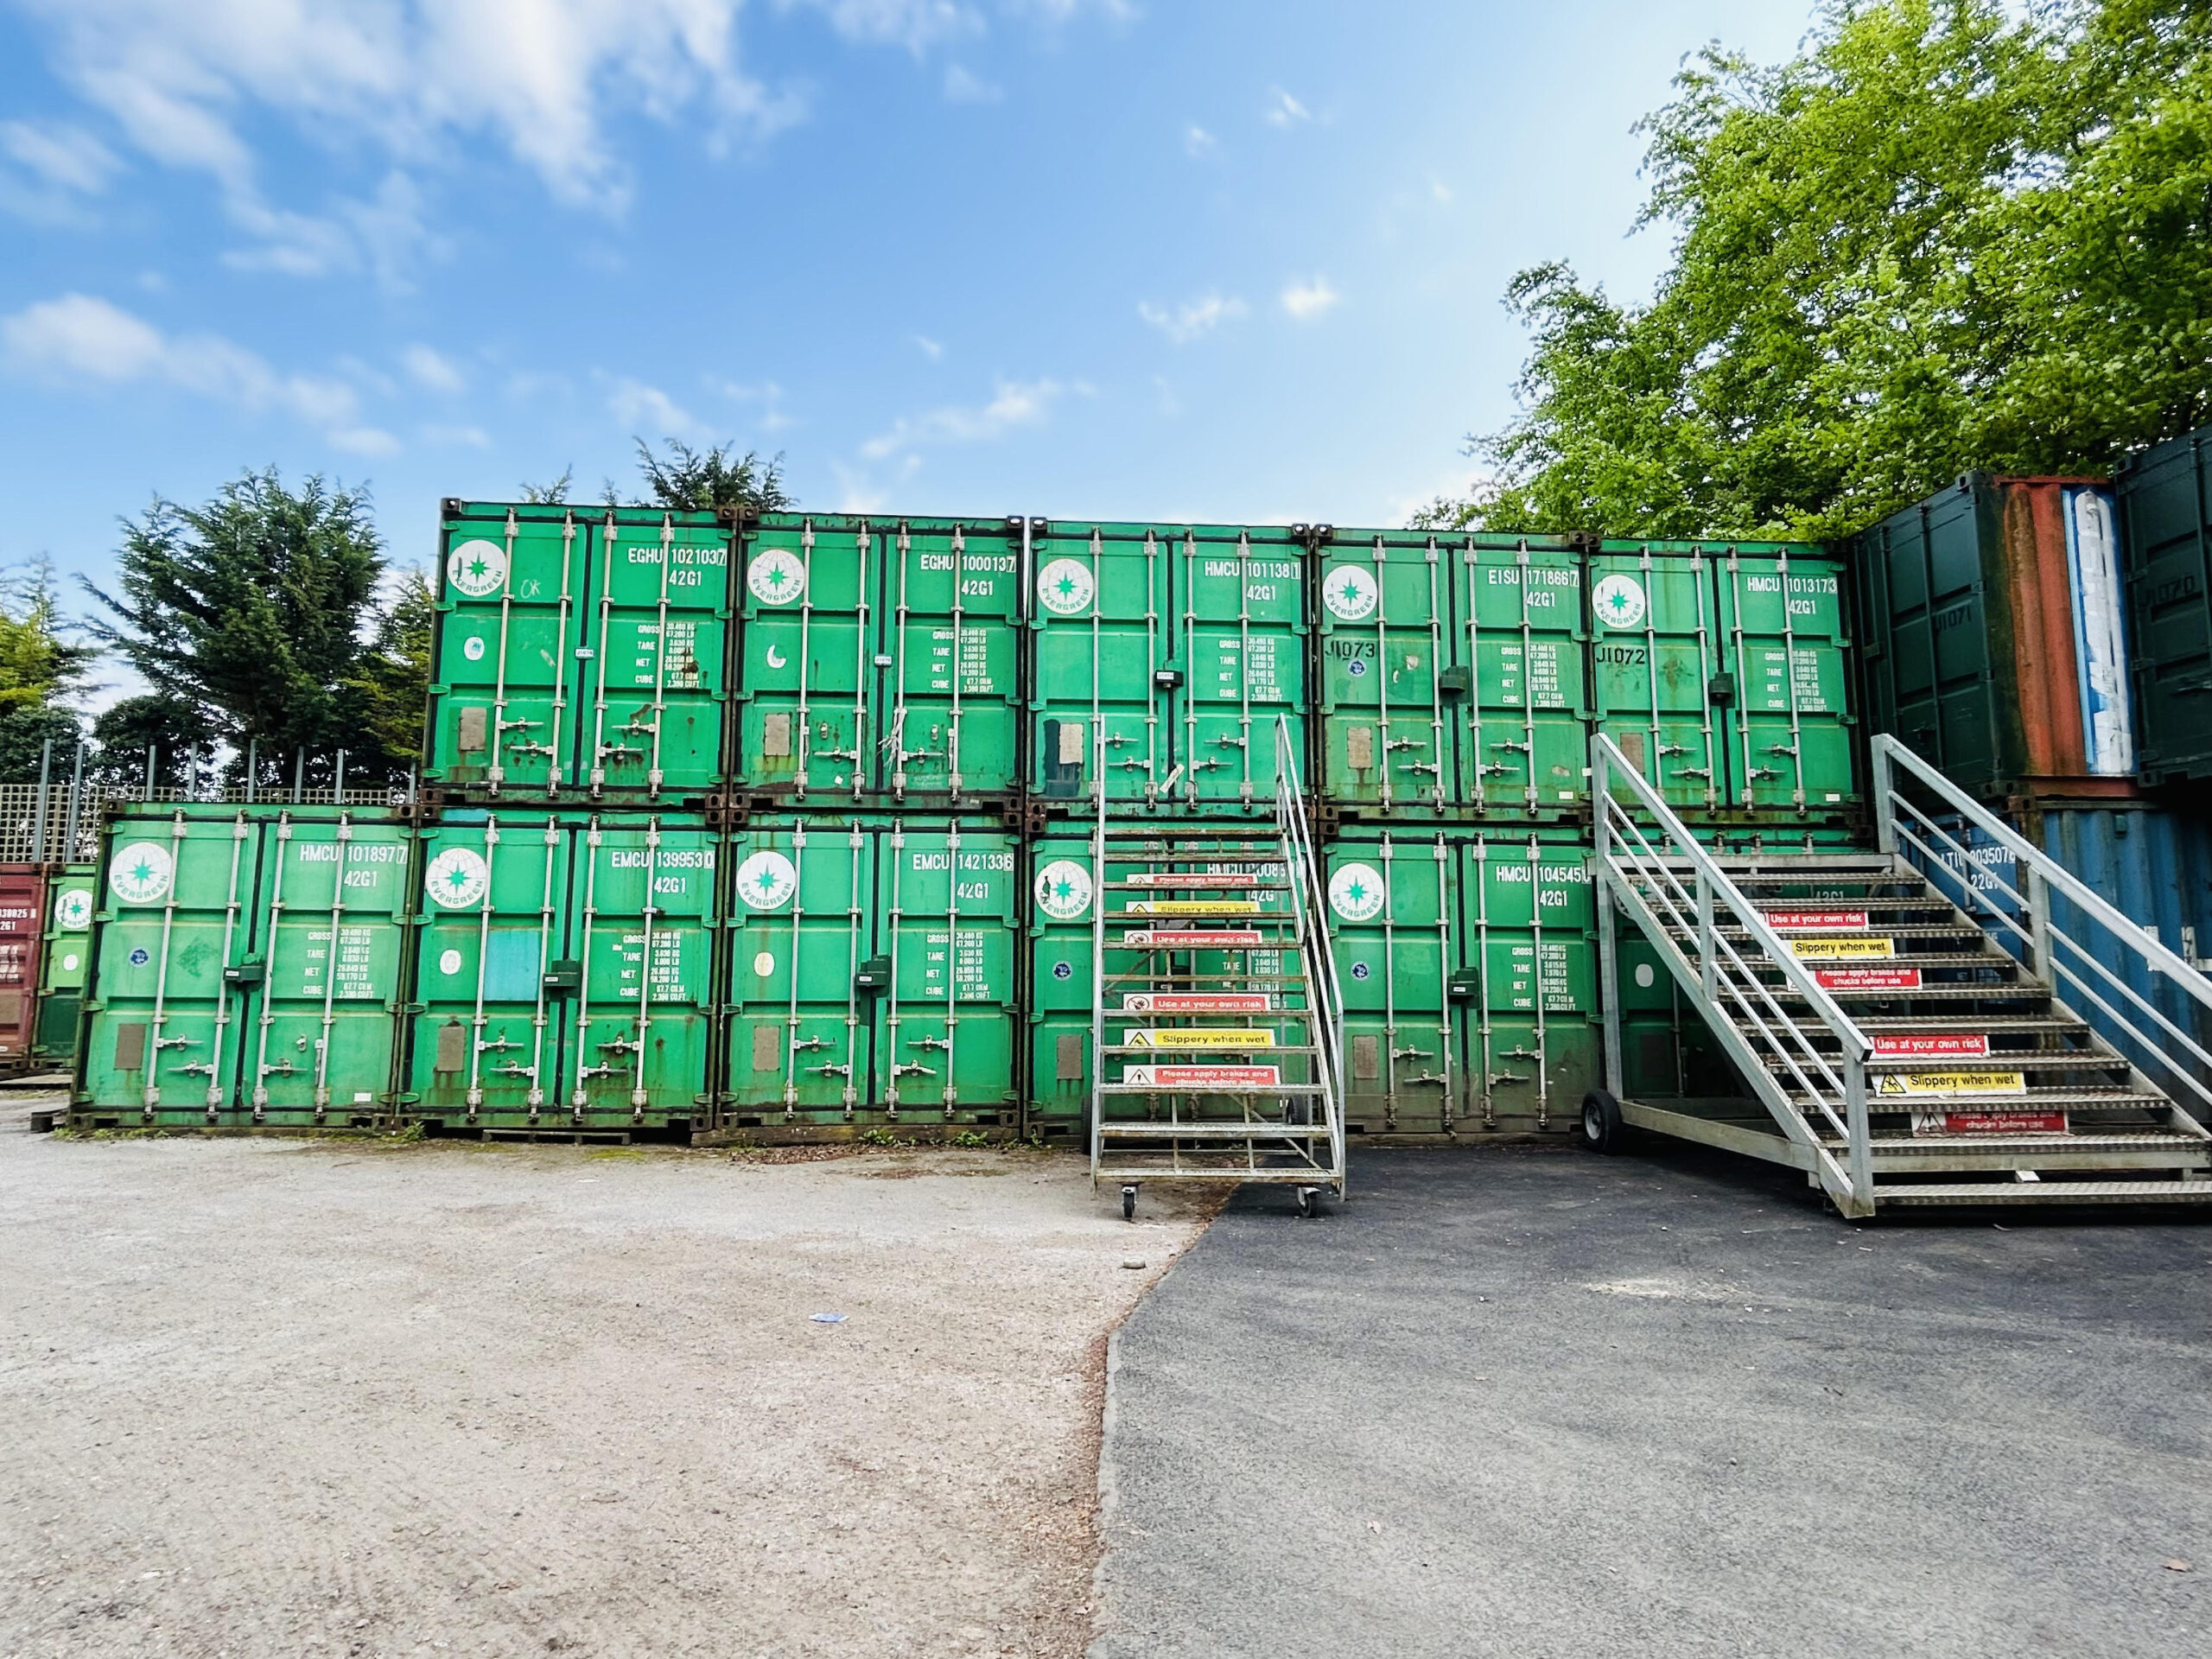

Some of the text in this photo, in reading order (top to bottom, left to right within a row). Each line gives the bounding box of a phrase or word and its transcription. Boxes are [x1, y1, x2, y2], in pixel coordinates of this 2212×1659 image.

[628, 548, 727, 566] EGHU 1021037
[920, 555, 1016, 572] EGHU 1000137
[1205, 562, 1240, 576] HMCU
[669, 570, 702, 586] 42G1
[1488, 570, 1579, 587] EISU 1718667
[753, 579, 800, 601] EVERGREEN
[961, 580, 993, 595] 42G1
[1747, 577, 1837, 594] HMCU 1013173
[1042, 588, 1089, 610] EVERGREEN
[1247, 585, 1275, 601] 42G1
[1527, 592, 1554, 607] 42G1
[1327, 594, 1373, 616] EVERGREEN
[1789, 600, 1815, 614] 42G1
[1597, 602, 1641, 625] EVERGREEN
[638, 625, 660, 633] GROSS
[933, 631, 954, 639] GROSS
[638, 641, 655, 650] TARE
[1596, 648, 1645, 664] J1072
[932, 664, 945, 672] NET
[1502, 663, 1517, 671] TARE
[635, 675, 653, 683] CUBE
[1219, 672, 1232, 681] NET
[931, 680, 949, 689] CUBE
[1219, 689, 1236, 697] CUBE
[300, 844, 408, 864] HMCU 1018977
[612, 850, 715, 868] EMCU 1399530
[912, 853, 1014, 871] EMCU 1421336
[344, 871, 377, 887] 42G1
[1496, 867, 1531, 882] HMCU
[114, 874, 168, 899] EVERGREEN
[654, 877, 685, 893] 42G1
[957, 882, 988, 899] 42G1
[431, 880, 483, 905] EVERGREEN
[741, 882, 791, 906] EVERGREEN
[1540, 891, 1567, 906] 42G1
[1333, 894, 1380, 917] EVERGREEN
[1771, 914, 1788, 923] Use
[1791, 914, 1799, 923] at
[1802, 915, 1821, 925] your
[1846, 913, 1862, 922] risk
[308, 950, 325, 958] TARE
[1512, 947, 1533, 956] GROSS
[1796, 944, 1836, 954] Slippery
[623, 952, 641, 961] TARE
[927, 952, 944, 961] TARE
[305, 968, 320, 976] NET
[1223, 962, 1240, 970] TAE
[1512, 964, 1530, 973] TARE
[621, 969, 636, 978] NET
[303, 985, 323, 995] CUBE
[620, 988, 639, 996] CUBE
[925, 987, 944, 995] CUBE
[1514, 998, 1532, 1007] CUBE
[1163, 1035, 1208, 1044] Slippery
[1877, 1039, 1982, 1052] Use at your own risk
[1911, 1075, 2015, 1087] Slippery when wet
